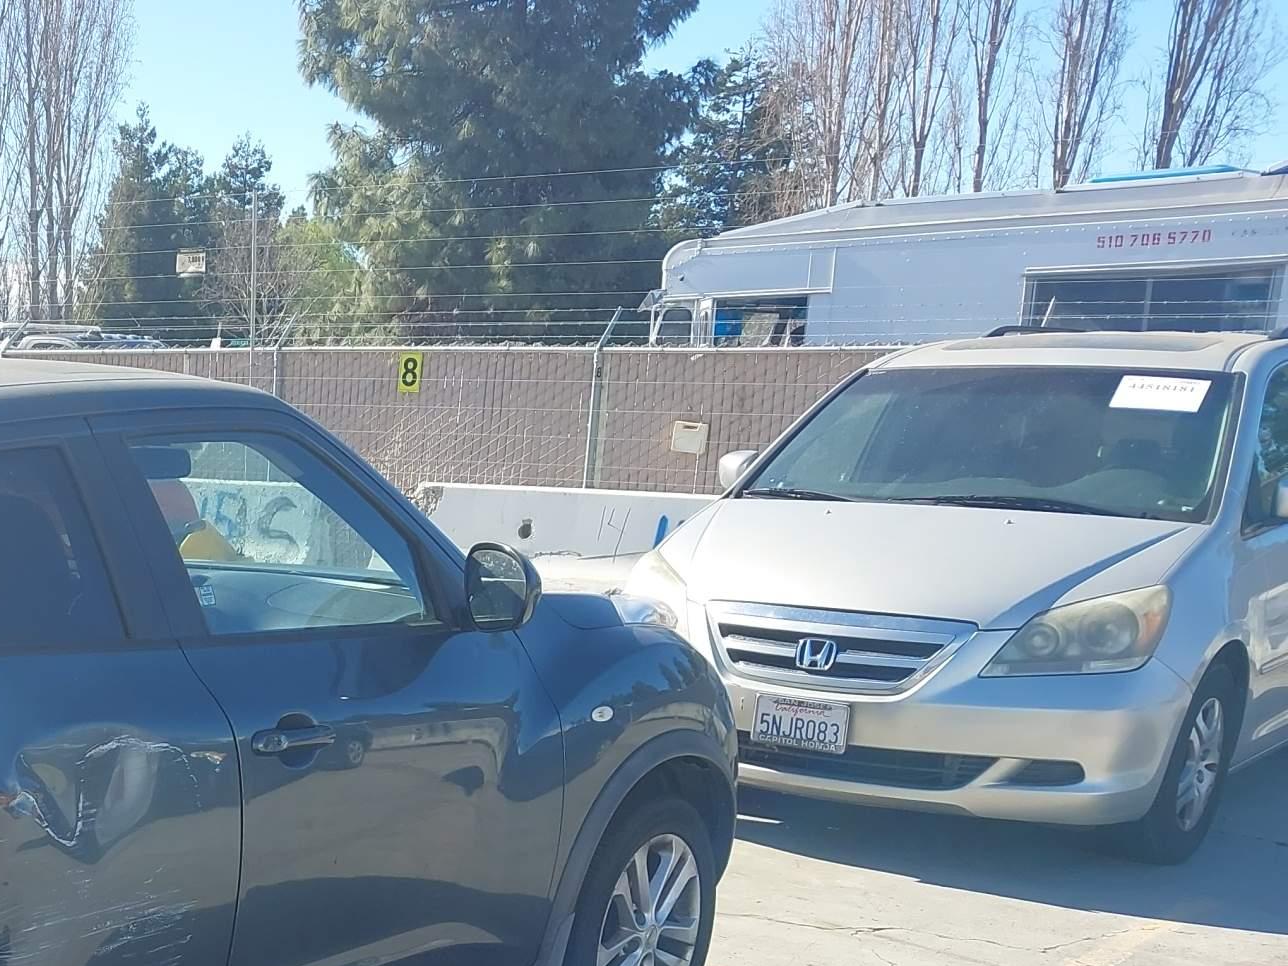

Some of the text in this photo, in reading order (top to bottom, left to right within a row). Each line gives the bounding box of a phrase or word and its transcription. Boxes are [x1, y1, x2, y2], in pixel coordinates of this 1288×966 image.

[1096, 235, 1124, 249] 510
[1167, 229, 1212, 245] 5770
[400, 357, 418, 387] 8
[759, 712, 840, 744] 5NJR083
